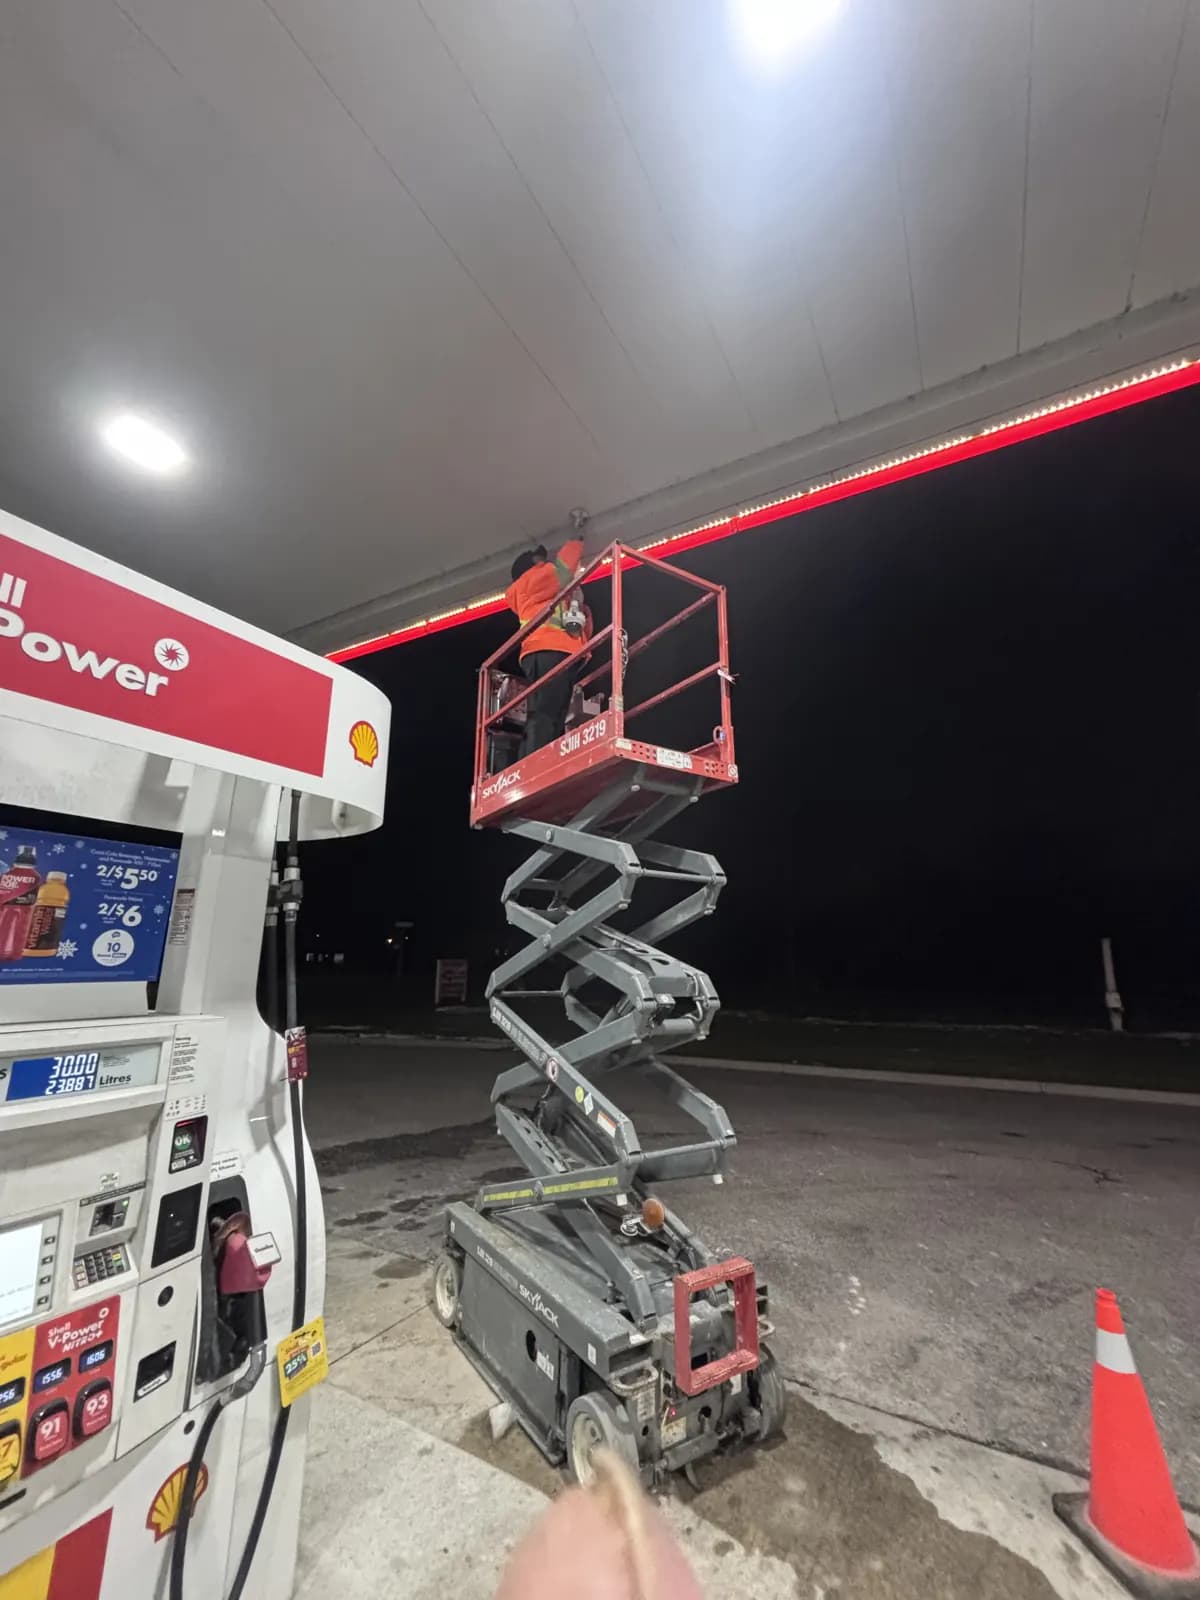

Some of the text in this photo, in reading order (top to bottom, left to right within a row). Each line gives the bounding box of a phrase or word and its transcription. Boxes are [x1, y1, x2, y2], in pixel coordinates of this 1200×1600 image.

[582, 719, 606, 745] 3219
[107, 942, 121, 953] 10
[99, 1074, 133, 1086] Litres
[174, 1133, 192, 1147] OK
[519, 1283, 559, 1329] SKYJACK
[47, 1320, 105, 1350] V-Power
[48, 1321, 71, 1338] Shell
[87, 1393, 108, 1417] 93
[41, 1416, 61, 1441] 91
